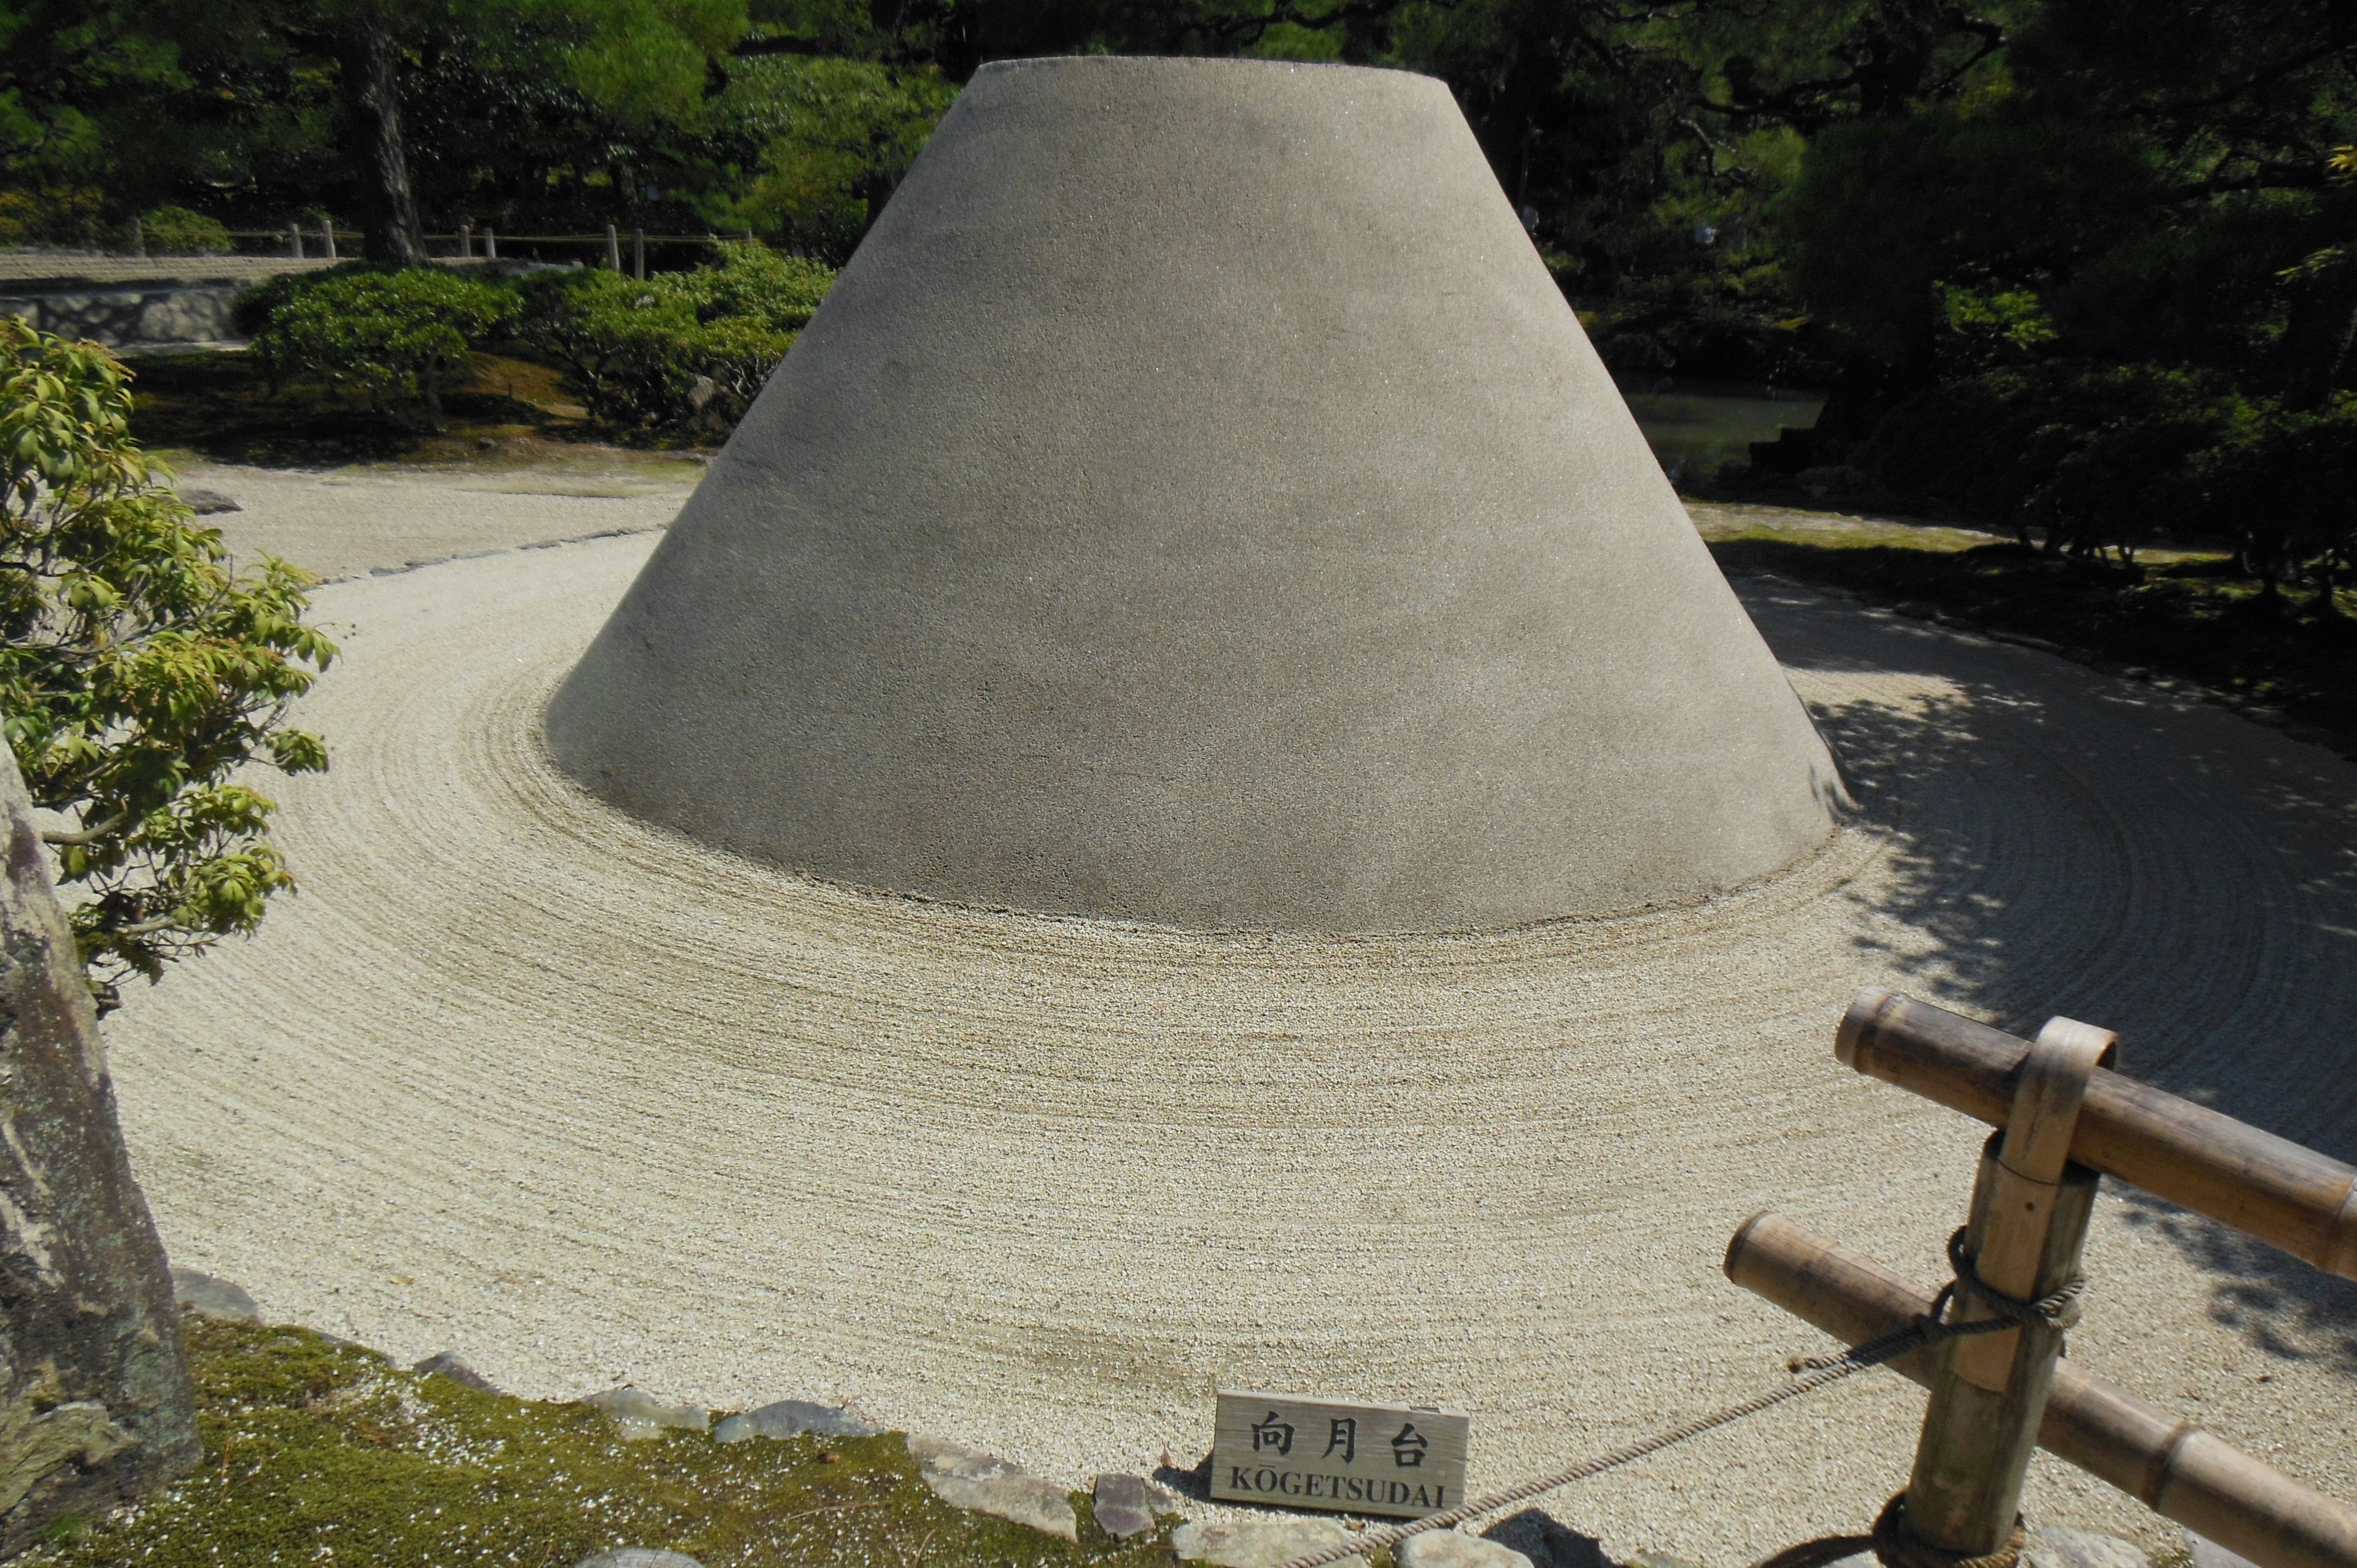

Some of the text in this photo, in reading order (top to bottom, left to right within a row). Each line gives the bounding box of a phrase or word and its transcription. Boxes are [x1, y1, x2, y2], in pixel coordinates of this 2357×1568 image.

[1251, 1411, 1428, 1468] 向月台
[1229, 1464, 1446, 1508] KŌGETSUDAI
